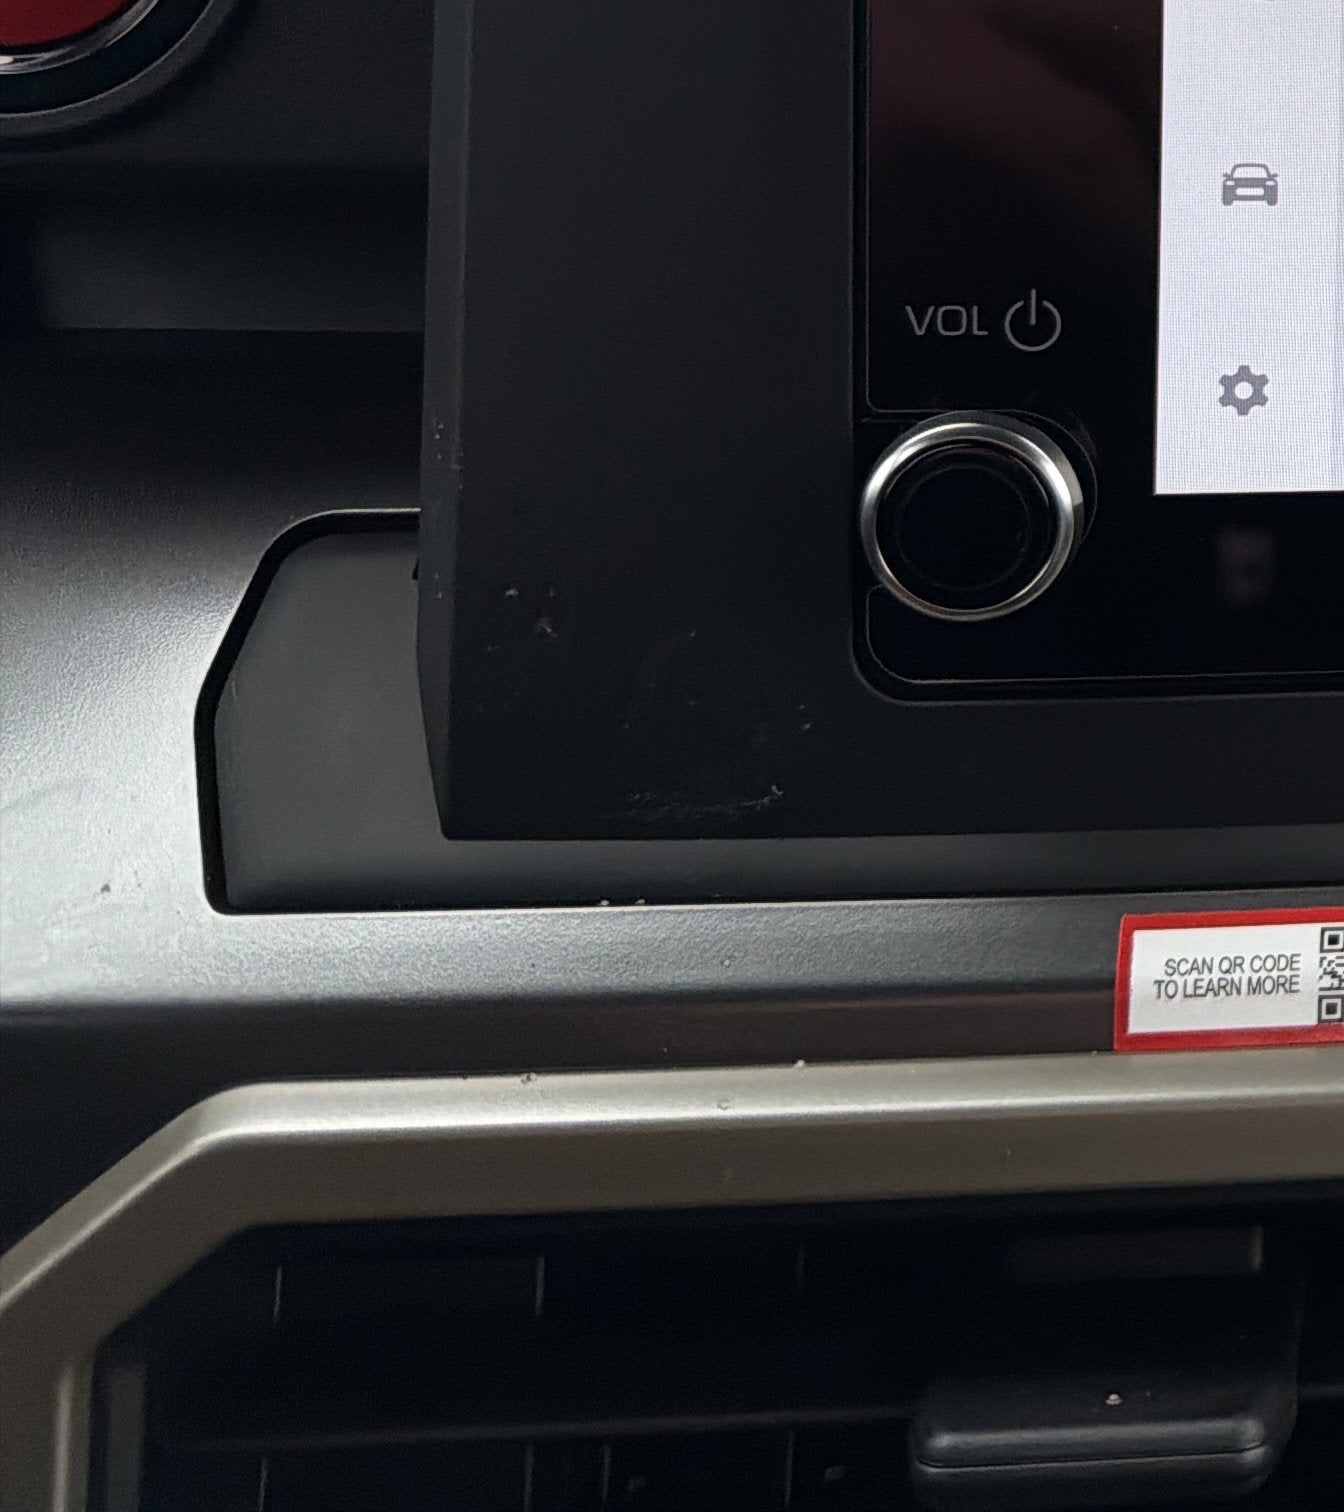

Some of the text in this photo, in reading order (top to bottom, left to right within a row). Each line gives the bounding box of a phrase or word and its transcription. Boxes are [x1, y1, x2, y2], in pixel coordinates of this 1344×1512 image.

[904, 305, 989, 336] VOL
[1164, 953, 1301, 977] SCAN QR CODE
[1153, 974, 1301, 1000] TO LEARN MORE
